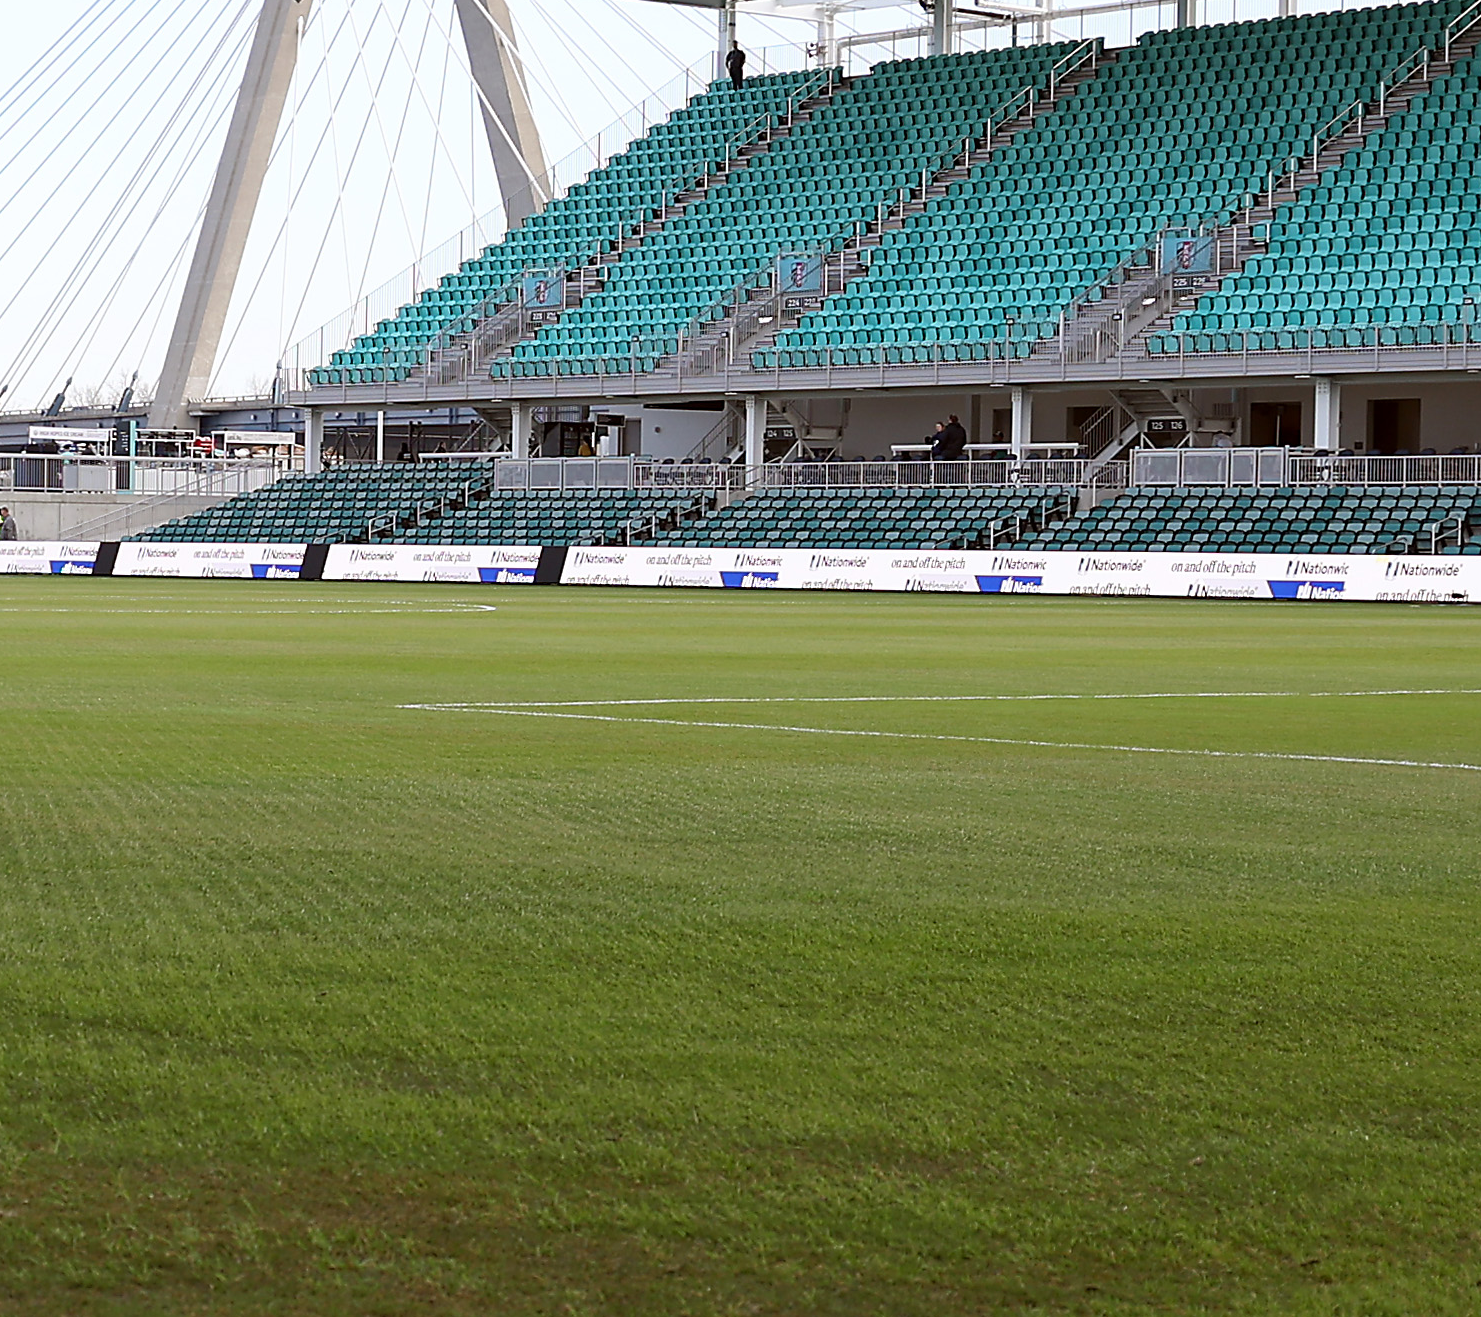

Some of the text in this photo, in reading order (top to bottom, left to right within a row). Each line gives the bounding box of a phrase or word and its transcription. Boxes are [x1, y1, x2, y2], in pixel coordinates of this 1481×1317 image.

[359, 550, 394, 560] Nationwide
[585, 553, 624, 564] Nationwide
[822, 556, 867, 567] Nationwide
[1091, 559, 1143, 571] Nationwide
[1172, 560, 1256, 577] on and off the pitch
[1400, 564, 1459, 576] Nationwide
